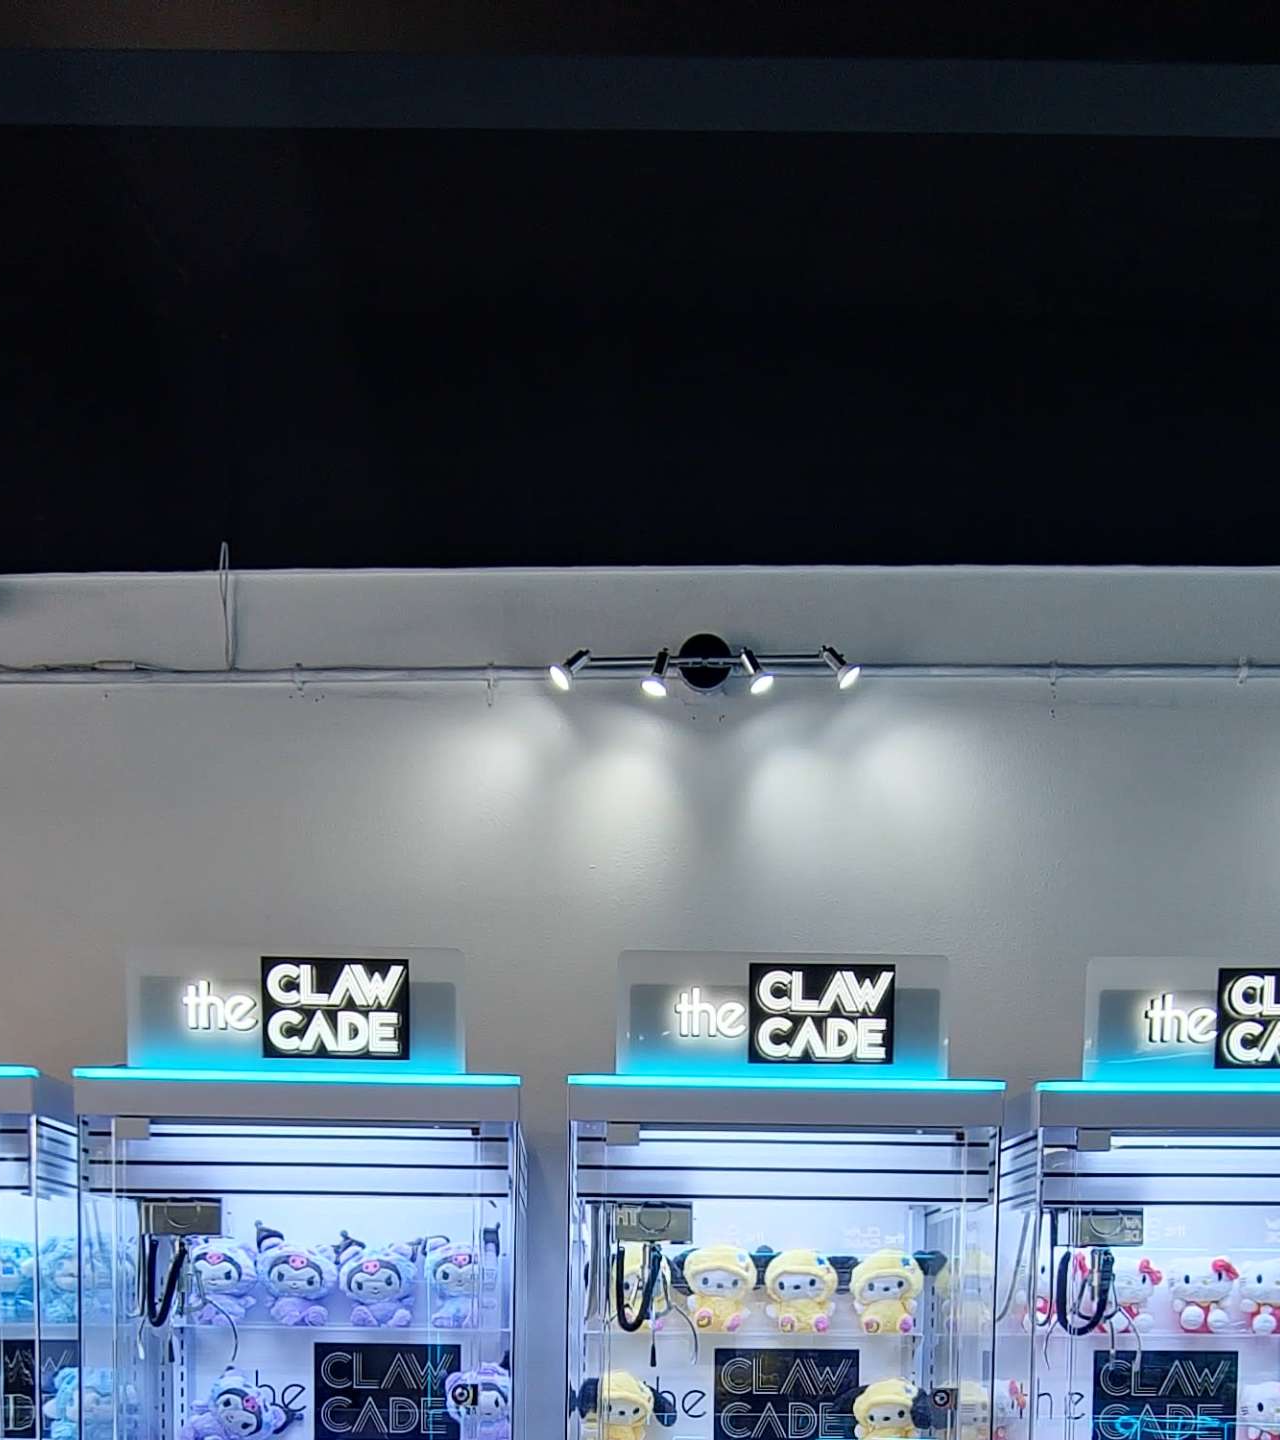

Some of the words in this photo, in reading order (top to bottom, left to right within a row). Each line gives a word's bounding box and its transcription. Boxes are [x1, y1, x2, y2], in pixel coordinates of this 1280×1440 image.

[182, 980, 258, 1030] the
[266, 963, 406, 1008] CLAW
[675, 987, 746, 1037] the
[756, 970, 894, 1015] CLAW
[1145, 993, 1218, 1043] the
[267, 1010, 401, 1055] CADE
[756, 1016, 886, 1061] CADE
[254, 1369, 307, 1412] he
[321, 1352, 454, 1390] CLAW
[721, 1357, 853, 1396] CLAW
[1100, 1360, 1231, 1396] CLAW
[321, 1396, 449, 1434] CADE
[721, 1402, 846, 1439] CADE
[1099, 1404, 1225, 1440] CADE
